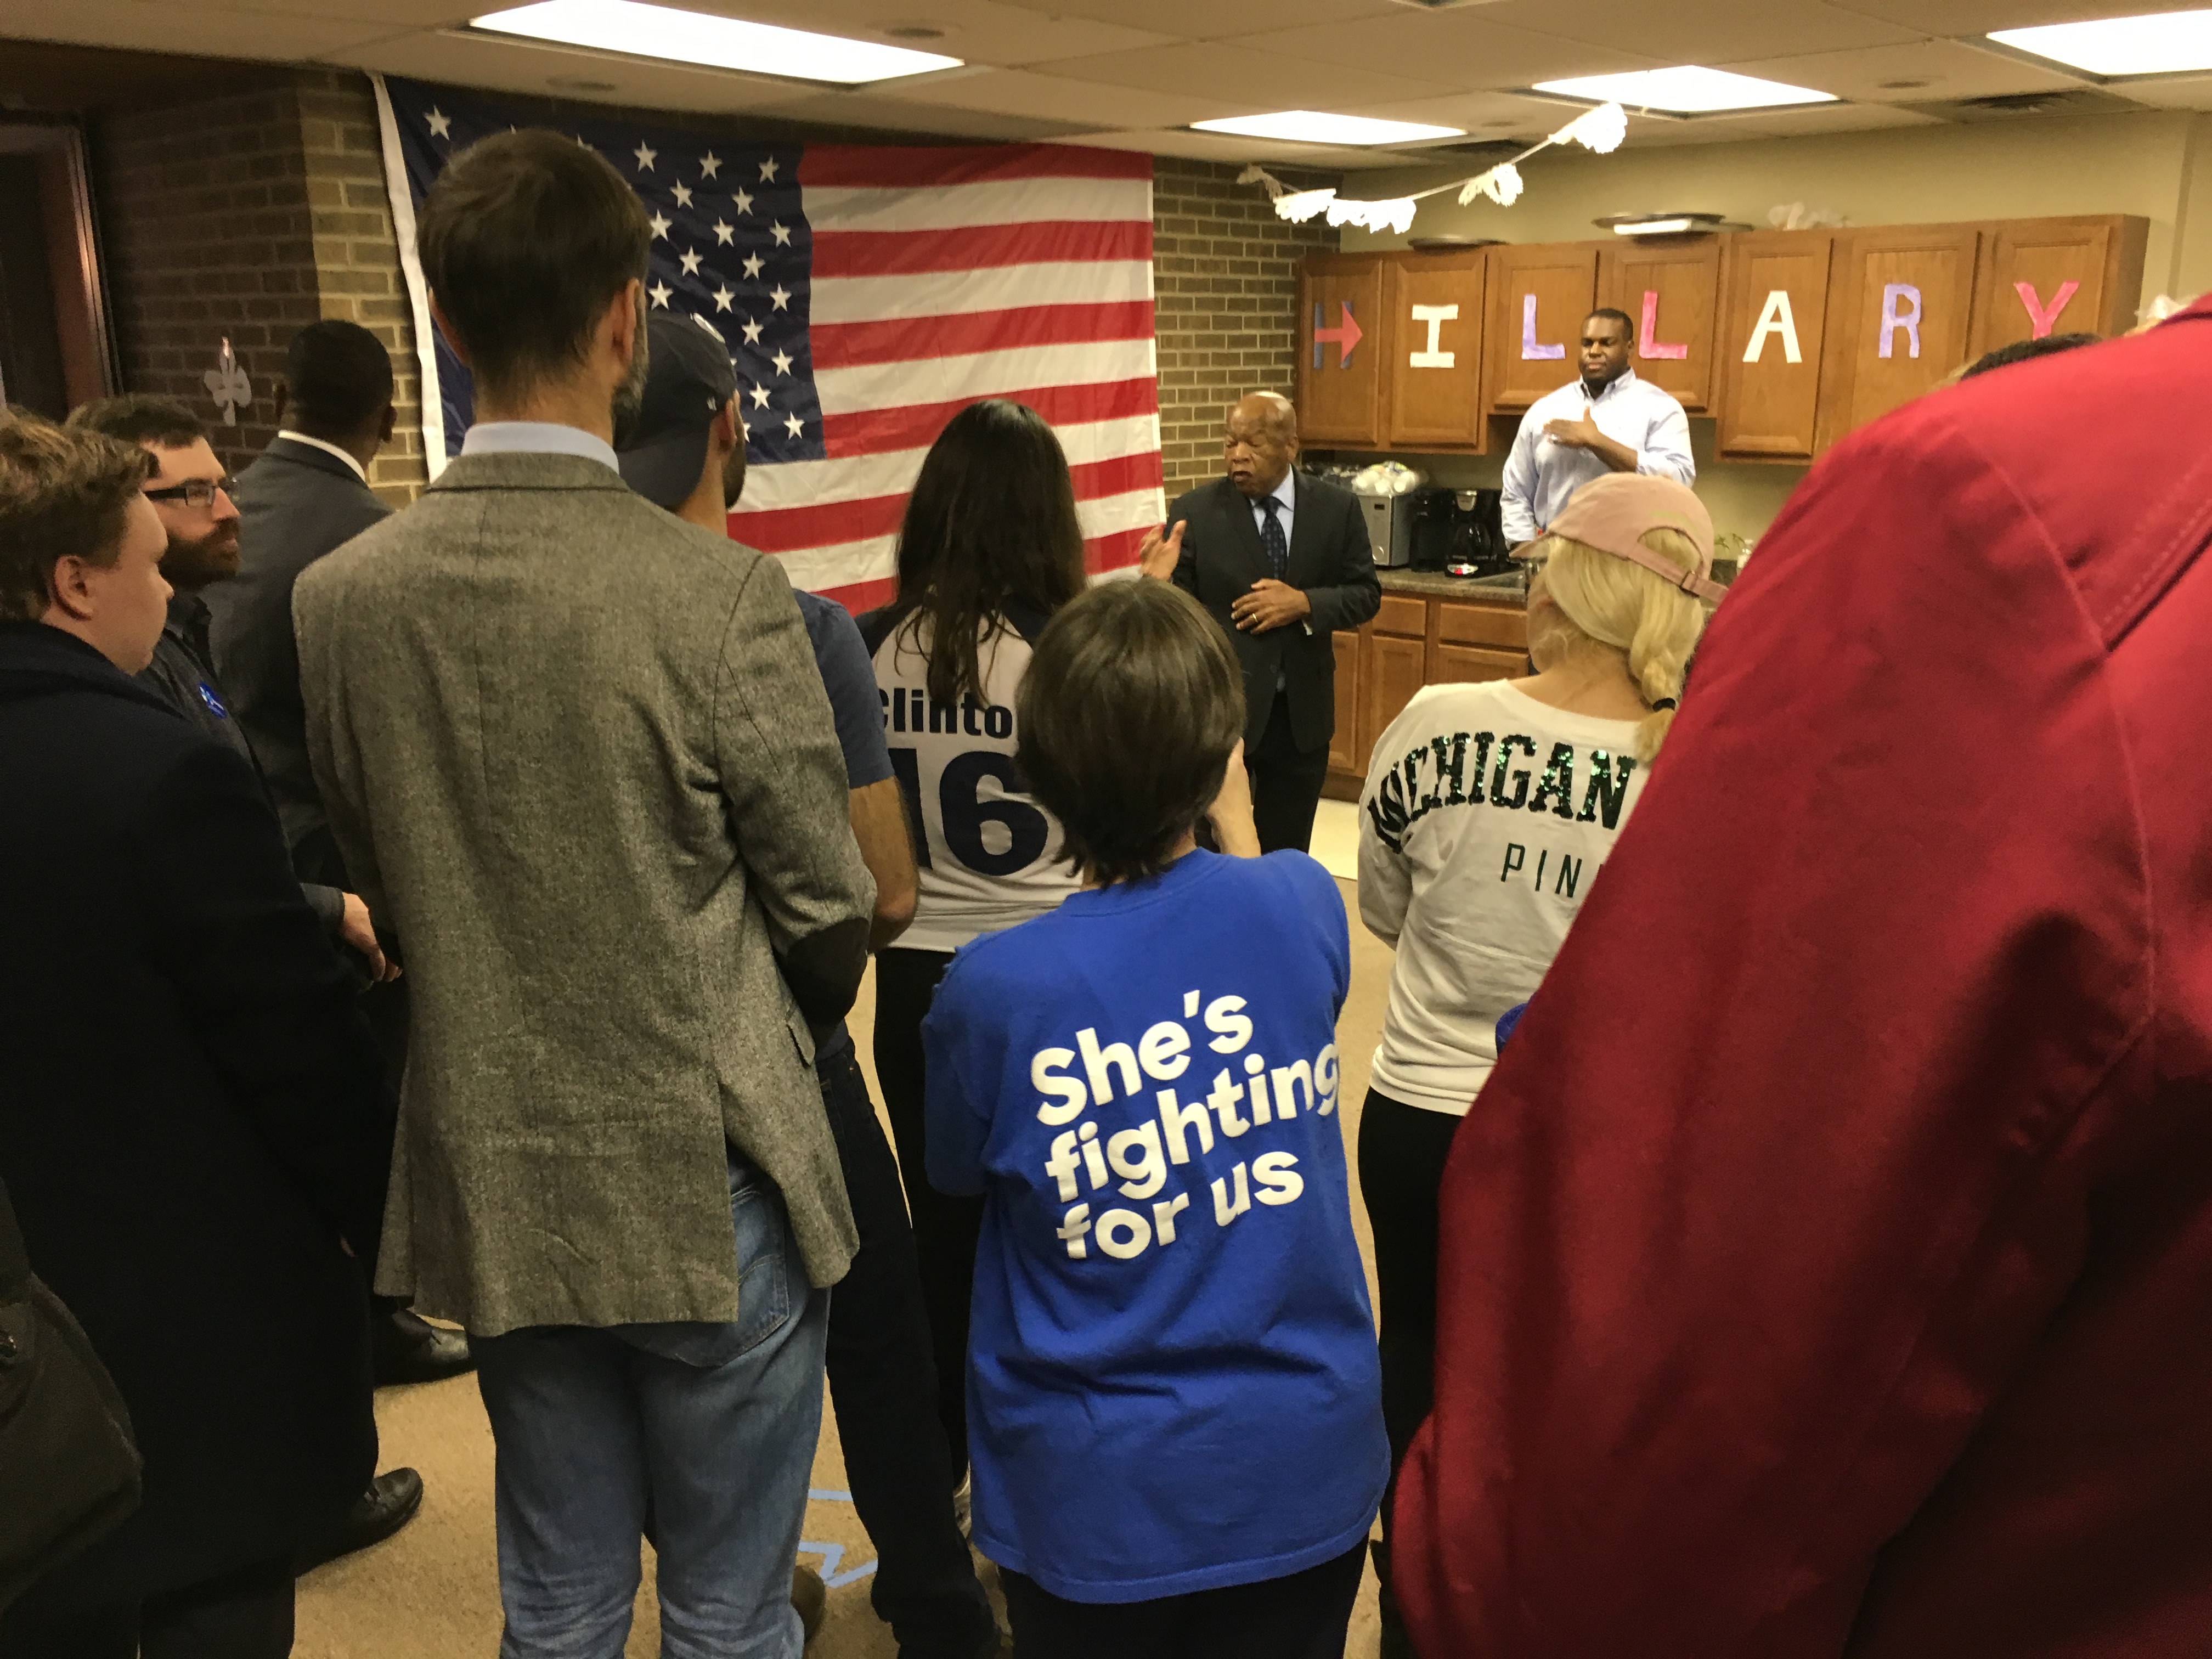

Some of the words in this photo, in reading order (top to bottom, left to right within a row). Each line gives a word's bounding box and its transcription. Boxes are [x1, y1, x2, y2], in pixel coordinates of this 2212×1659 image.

[1313, 281, 2080, 369] HILLARY
[1500, 843, 1603, 898] PIN
[1031, 989, 1253, 1125] She's
[1045, 1043, 1339, 1202] fighting
[1057, 1192, 1189, 1259] for
[1210, 1151, 1304, 1226] us
